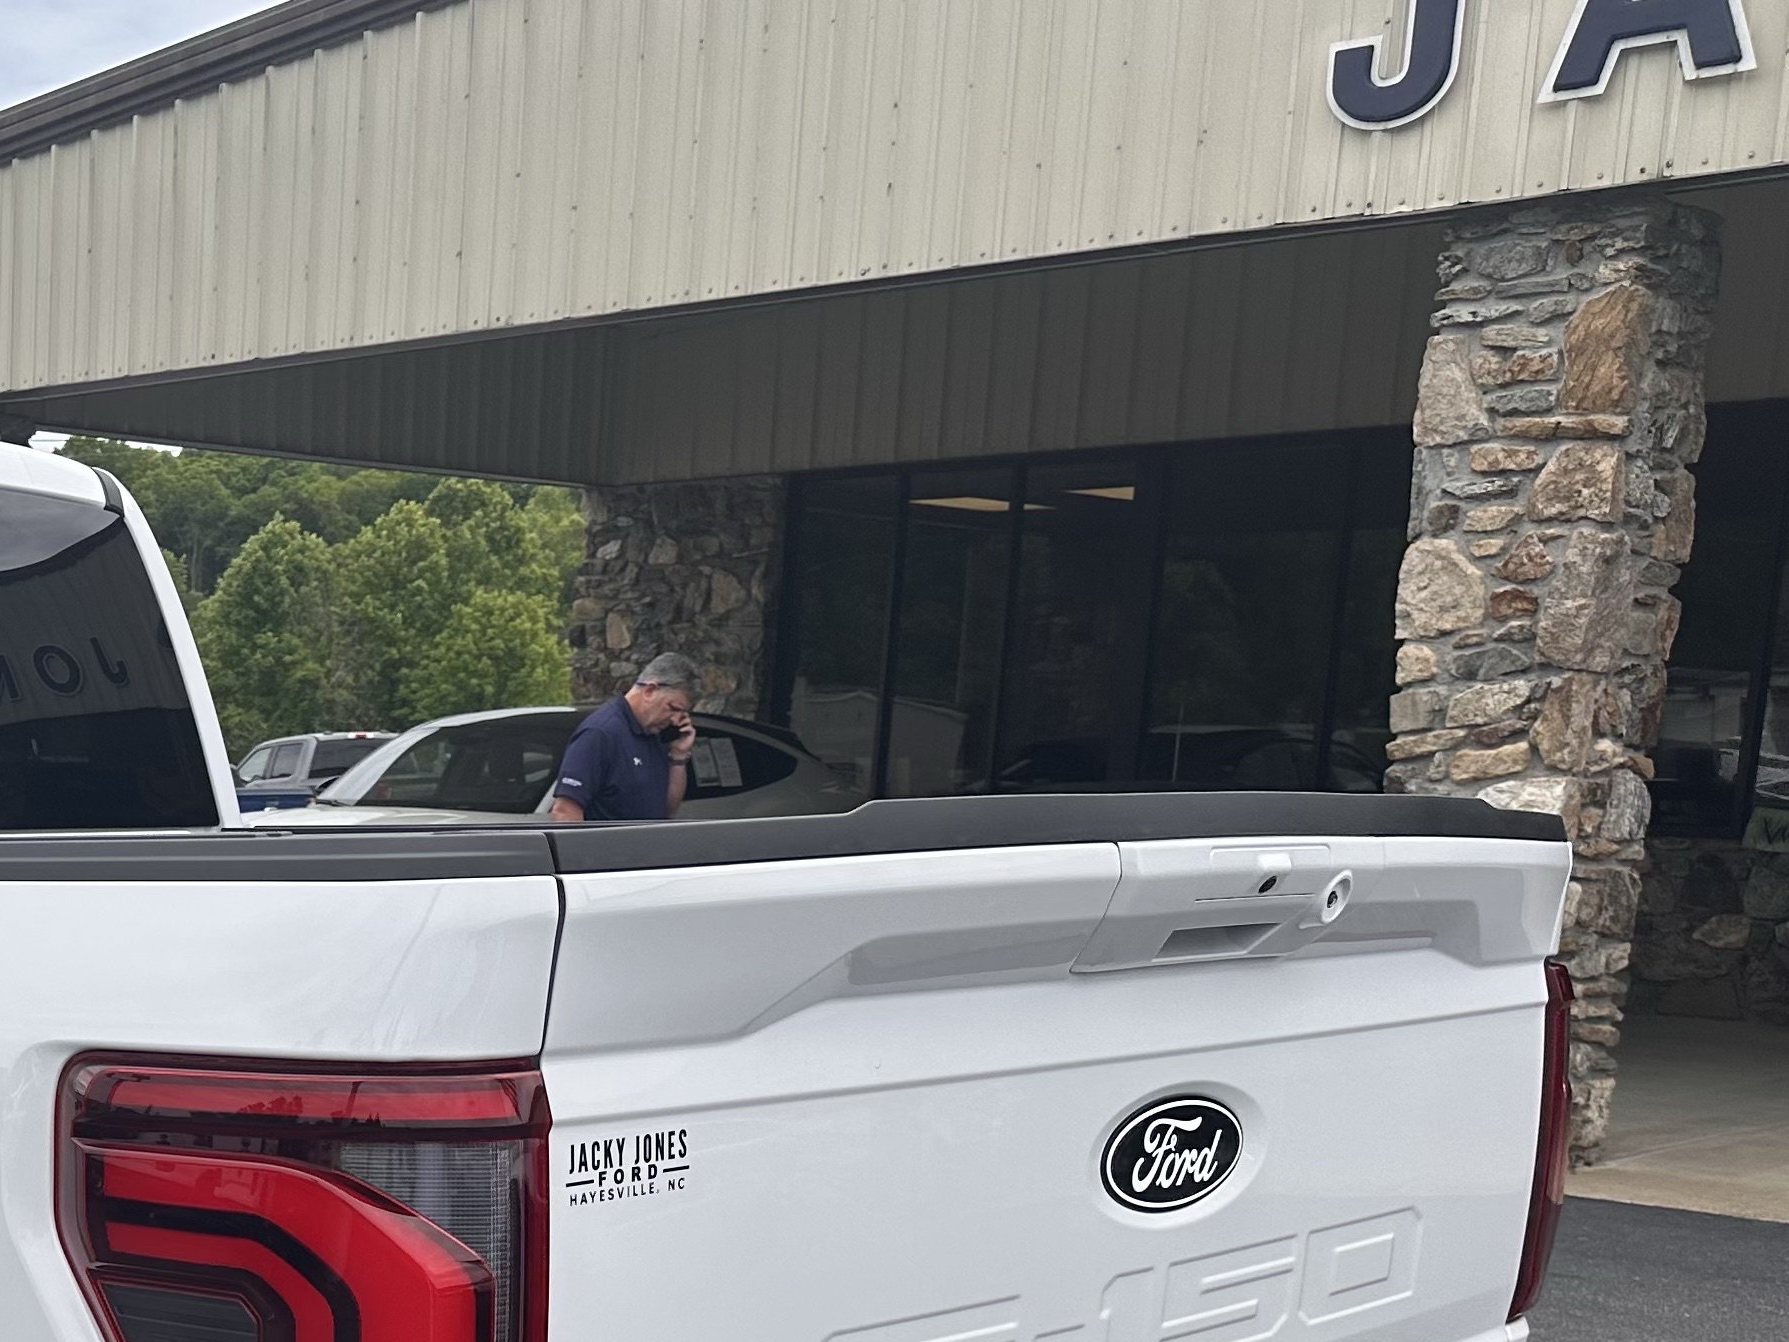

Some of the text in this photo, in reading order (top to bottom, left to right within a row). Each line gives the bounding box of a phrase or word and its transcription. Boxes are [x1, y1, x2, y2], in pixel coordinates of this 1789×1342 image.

[569, 1129, 688, 1174] JACKY JONES
[1131, 1115, 1223, 1193] Ford
[569, 1177, 686, 1207] HAYESVILLE, NC
[598, 1164, 658, 1187] FORD
